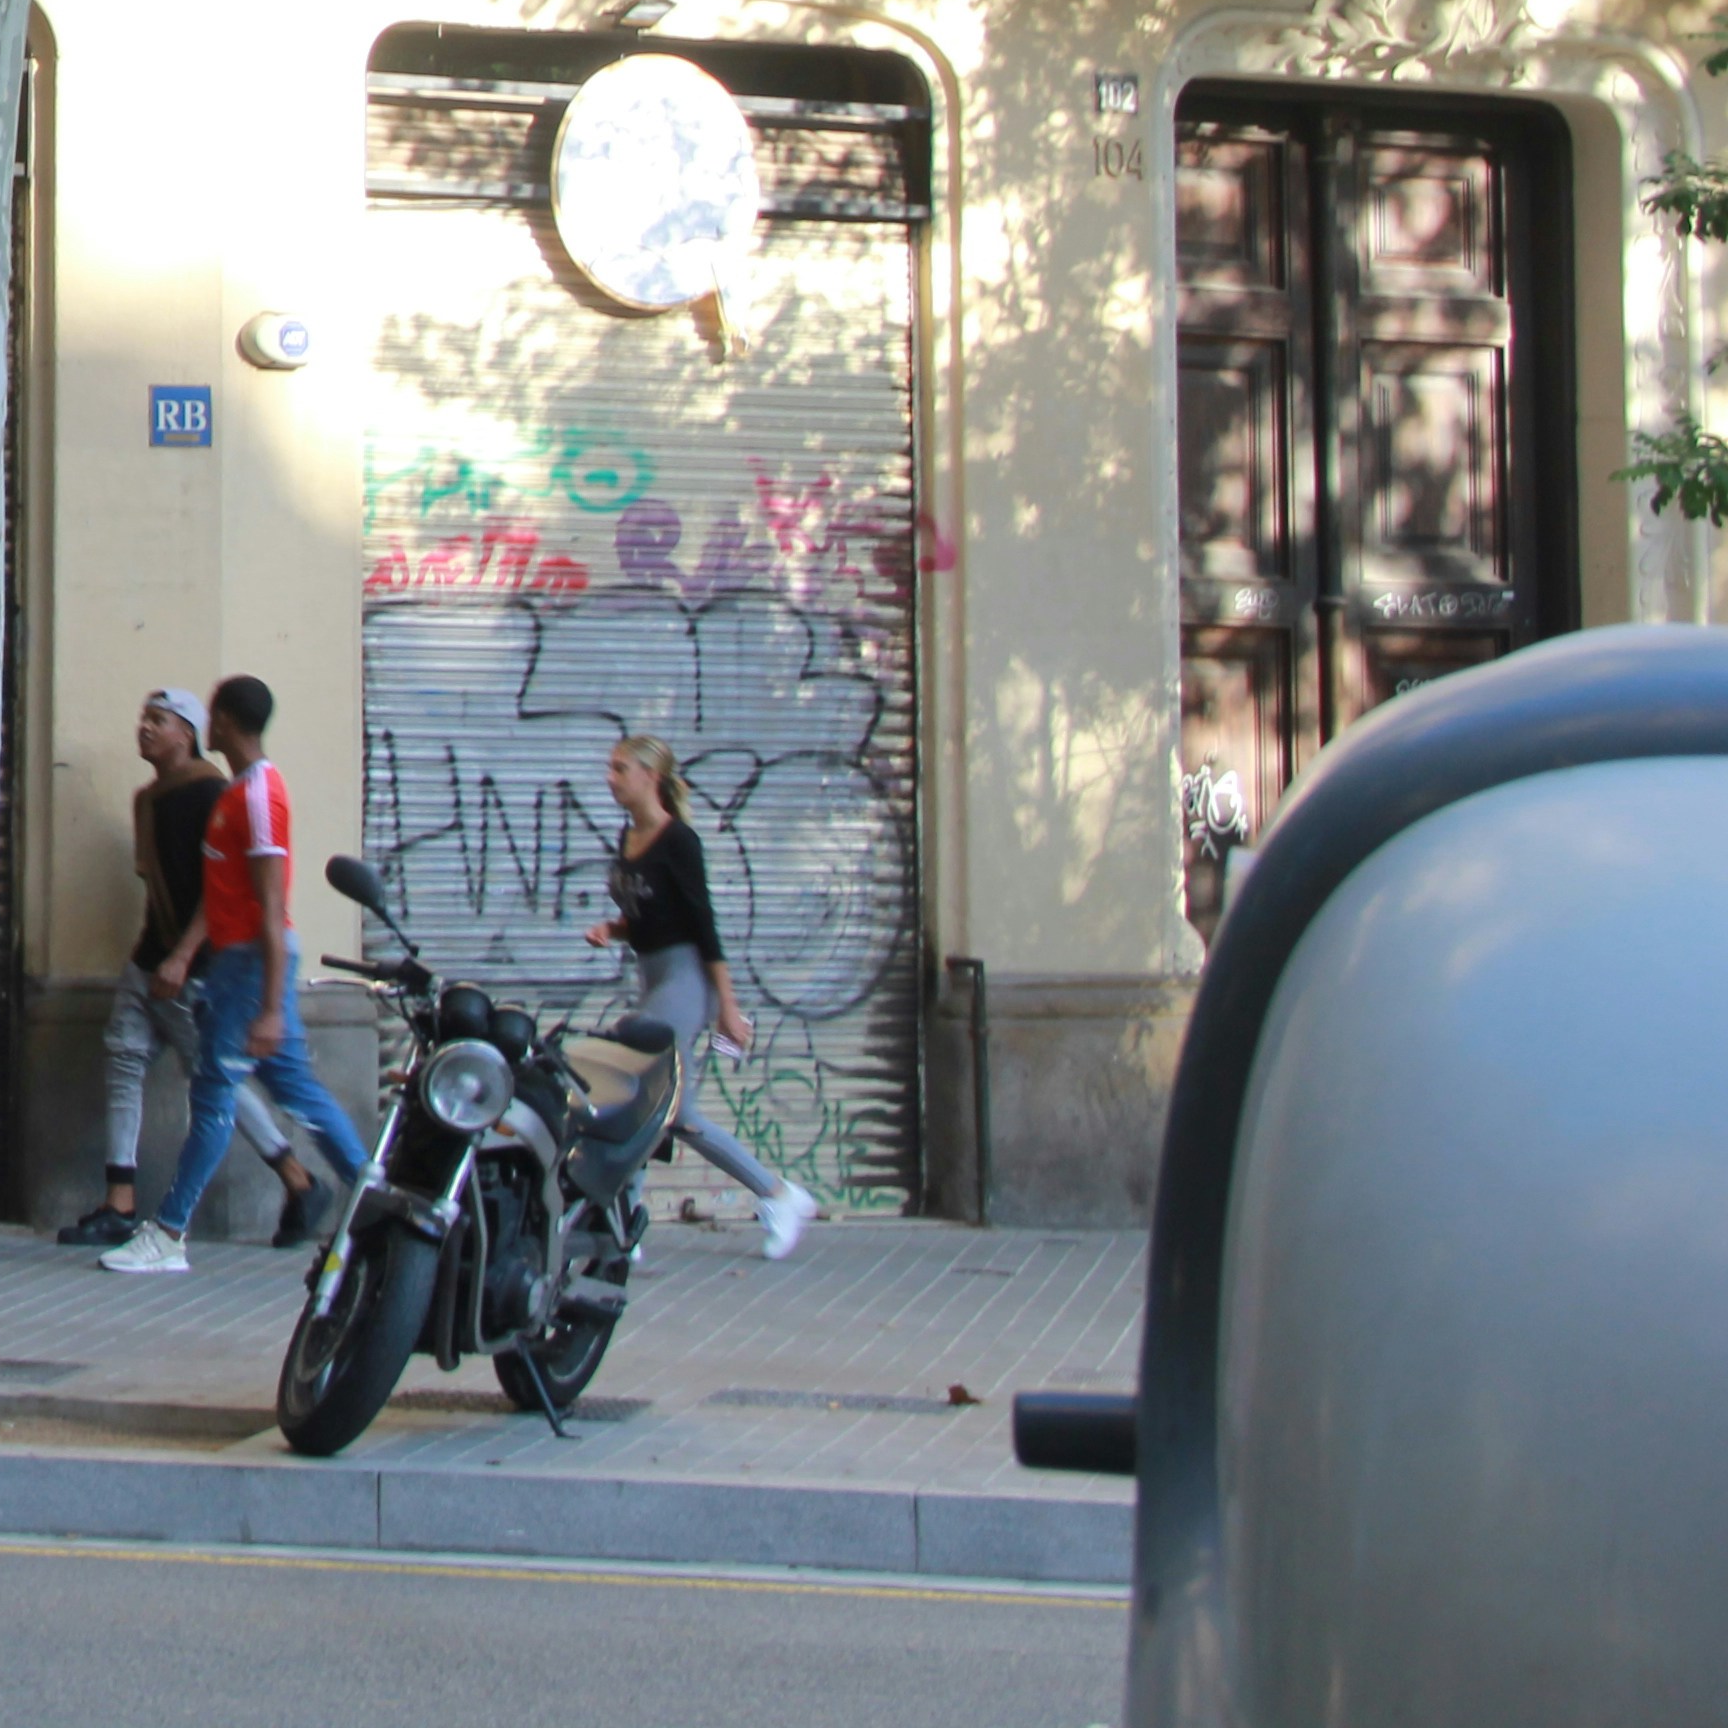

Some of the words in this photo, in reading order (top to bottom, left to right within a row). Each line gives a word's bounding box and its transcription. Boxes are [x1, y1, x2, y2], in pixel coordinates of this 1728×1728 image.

[1098, 80, 1136, 113] 102
[1092, 136, 1143, 181] 104
[156, 399, 207, 432] RB
